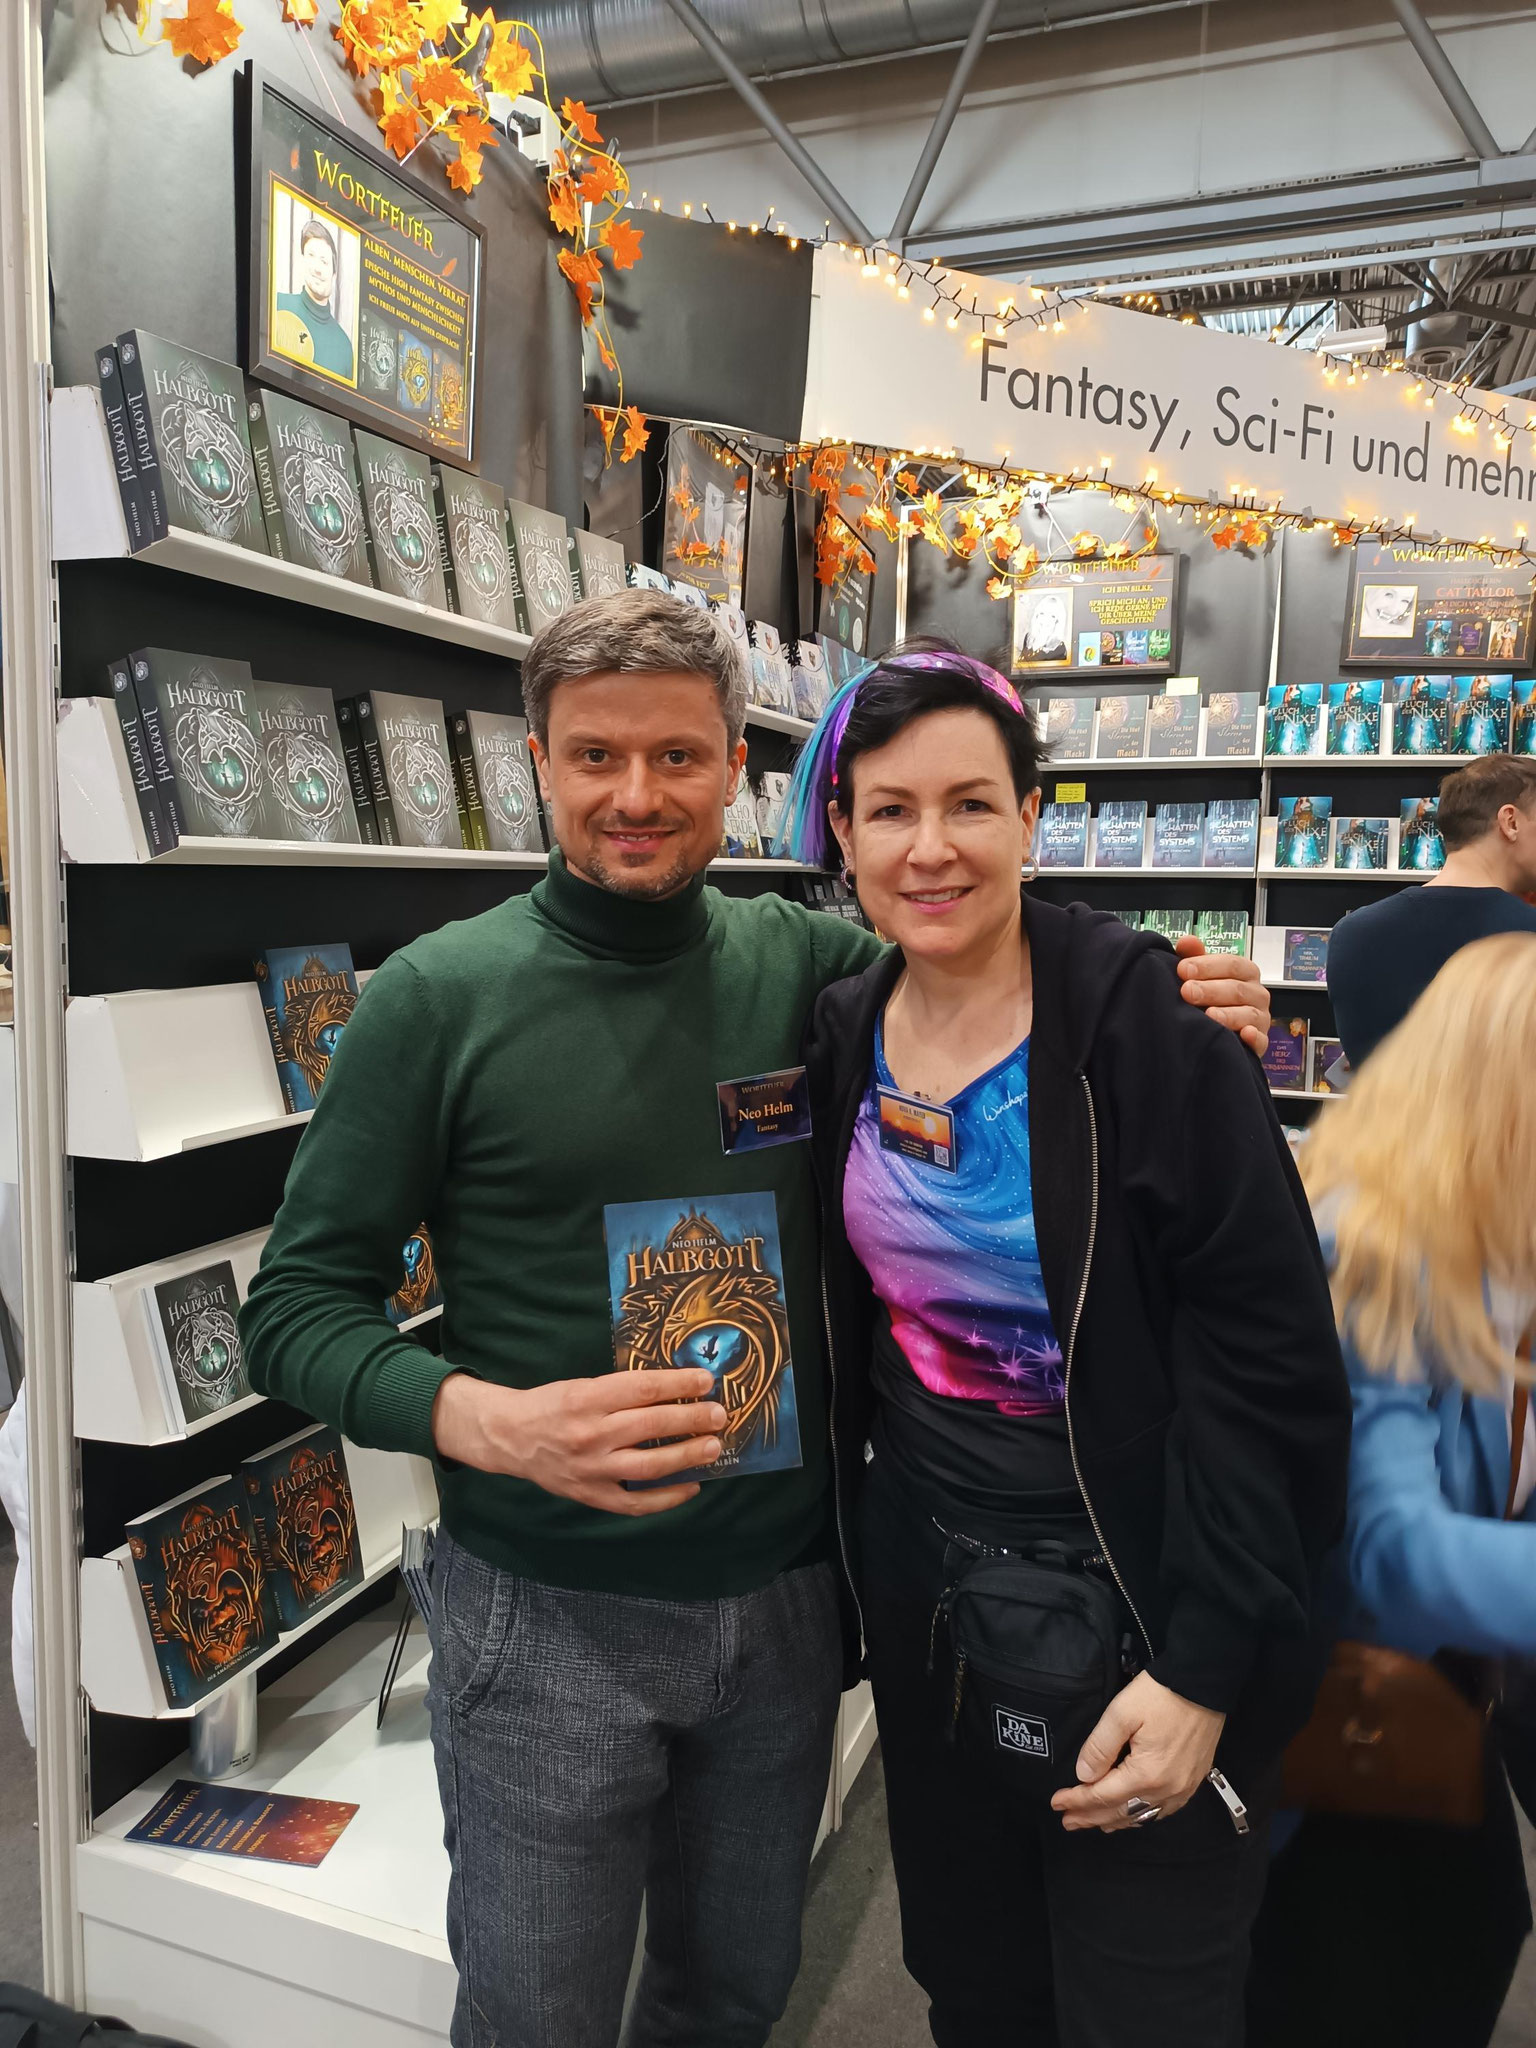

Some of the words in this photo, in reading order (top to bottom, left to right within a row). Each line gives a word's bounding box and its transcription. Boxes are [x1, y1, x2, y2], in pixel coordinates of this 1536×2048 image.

[313, 149, 443, 258] WORTFEUER
[364, 238, 392, 262] ALBEN.
[393, 255, 437, 290] MENSCHEN.
[437, 282, 466, 308] VERRAT.
[364, 258, 390, 280] EPISCHE
[391, 274, 408, 291] HIGH
[409, 285, 435, 307] FANTASY
[435, 300, 465, 325] ZWISCHEN
[368, 275, 395, 298] MYTHOS
[396, 291, 411, 307] UND
[411, 300, 462, 336] MENSCHLICHKEIT.
[368, 293, 379, 306] ICH
[396, 308, 410, 323] MICH
[153, 368, 237, 423] HALBGOTT
[979, 338, 1192, 453] Fantasy,
[1213, 385, 1335, 466] Sci-Fi
[1352, 421, 1429, 482] und
[106, 404, 138, 483] HALBGOTT
[127, 391, 157, 471] HALBGOTT
[276, 424, 347, 470] HALBGOTT
[253, 445, 281, 516] HALBGOTT
[368, 461, 427, 502] HALBGOTT
[450, 494, 500, 531] HALBGOTT
[519, 525, 562, 558] HALBGOTT
[583, 552, 621, 582] HALBGOTT
[1102, 586, 1115, 594] ICH
[1116, 585, 1129, 593] BIN
[1116, 598, 1136, 606] MICH
[1151, 596, 1168, 604] UND
[1436, 587, 1461, 597] CAT
[1466, 586, 1515, 597] TAYLOR
[1090, 605, 1104, 613] ICH
[166, 680, 247, 716] HALBGOTT
[1272, 706, 1300, 716] FLUCH
[1333, 705, 1361, 714] FLUCH
[1399, 700, 1428, 708] FLUCH
[1459, 700, 1489, 708] FLUCH
[258, 708, 329, 739] HALBGOTT
[1283, 713, 1316, 727] NIXE
[1345, 711, 1378, 726] NIXE
[1411, 707, 1447, 722] NIXE
[1471, 707, 1508, 722] NIXE
[142, 706, 174, 783] HALBGOTT
[383, 717, 440, 746] HALBGOTT
[121, 717, 154, 793] HALBGOTT
[477, 735, 524, 760] HALBGOTT
[1064, 749, 1085, 758] Macht
[1116, 749, 1138, 757] Macht
[1170, 747, 1192, 756] Macht
[1227, 746, 1250, 755] Macht
[345, 745, 371, 808] HALBGOTT
[364, 739, 390, 803] HALBGOTT
[459, 754, 482, 812] HALBGOTT
[1283, 819, 1310, 827] FLUCH
[1294, 826, 1328, 840] NIXE
[1417, 827, 1445, 842] NIX
[1046, 835, 1080, 844] SYSTEMS
[1102, 835, 1137, 844] SYSTEMS
[1159, 837, 1195, 846] SYSTEMS
[1212, 834, 1250, 844] SYSTEMS
[283, 970, 350, 1001] HALBGOTT
[265, 1006, 289, 1064] HALBGOTT
[738, 1107, 761, 1122] Neo
[764, 1101, 793, 1117] Helm
[757, 1123, 778, 1133] Fantasy
[672, 1238, 694, 1249] NEO
[696, 1237, 717, 1247] HELM
[627, 1236, 765, 1289] HALBGOTT
[168, 1283, 228, 1327] HALBGOTT
[714, 1456, 740, 1467] ALBEN
[272, 1449, 339, 1507] HALBGOTT
[161, 1504, 241, 1571] HALBGOTT
[253, 1514, 277, 1572] HALBGOTT
[141, 1581, 168, 1644] HALBGOTT
[1006, 1717, 1031, 1735] DA
[147, 1788, 202, 1839] WORTFEUER
